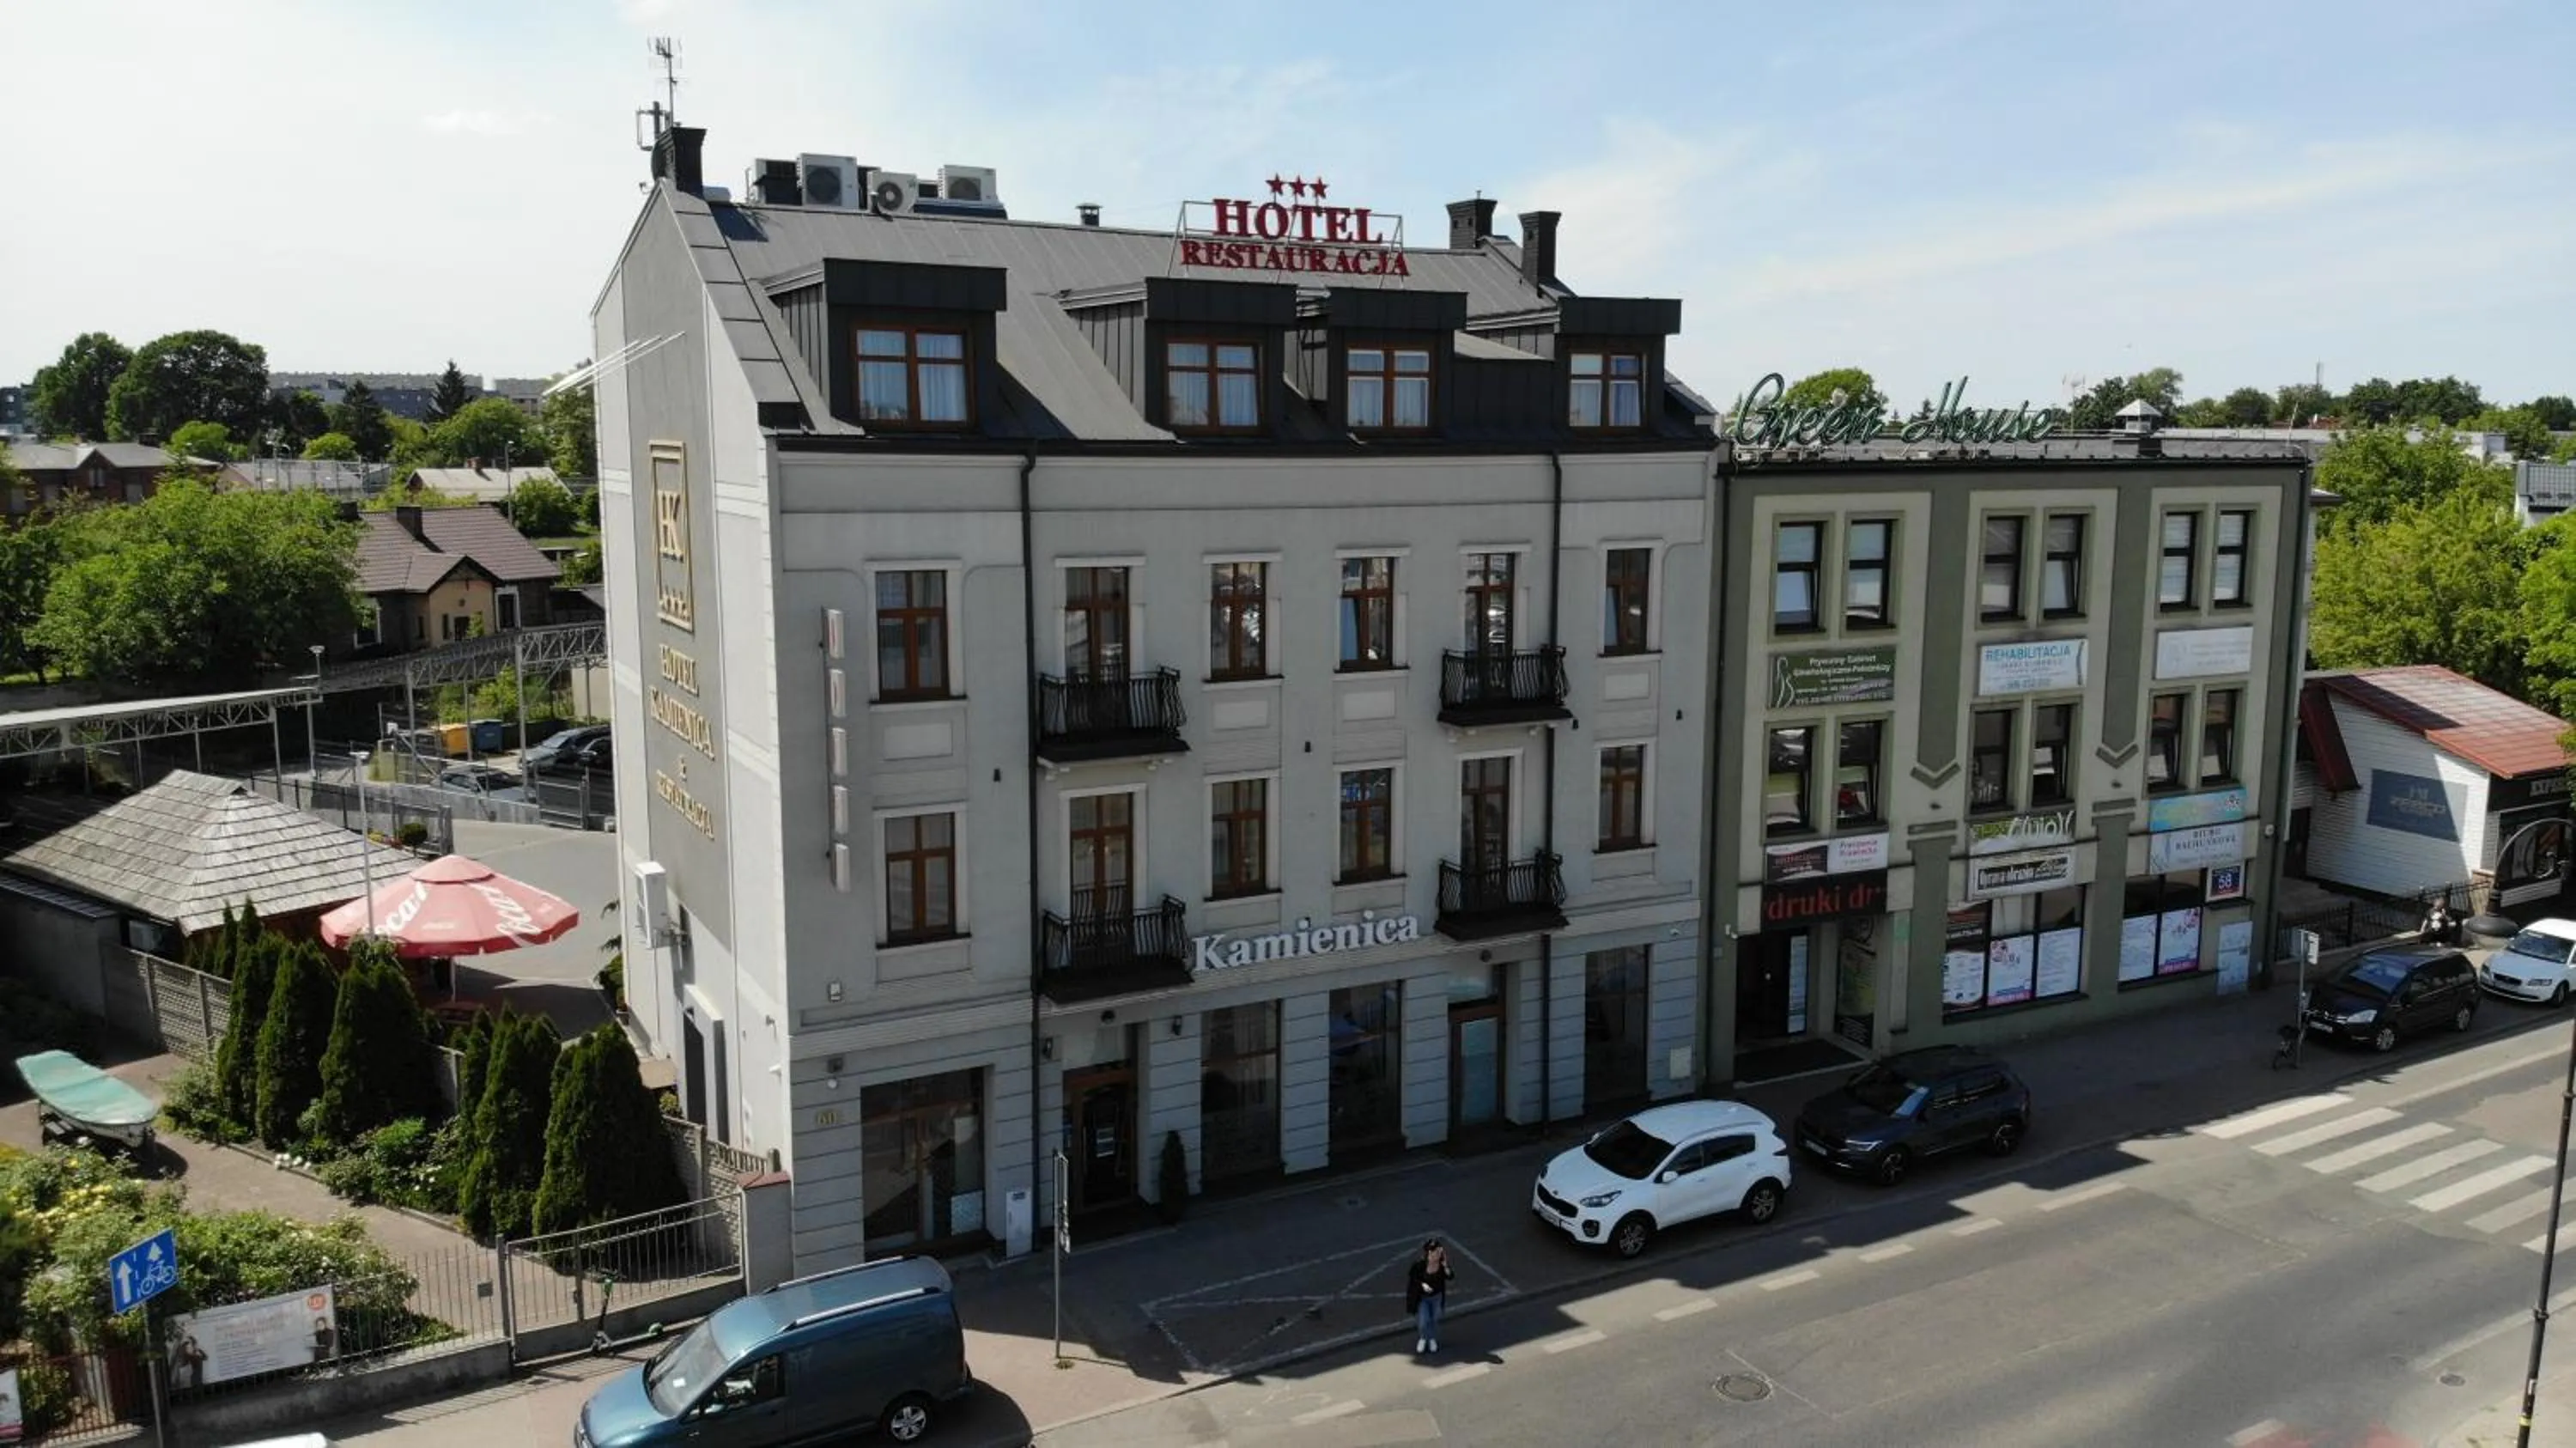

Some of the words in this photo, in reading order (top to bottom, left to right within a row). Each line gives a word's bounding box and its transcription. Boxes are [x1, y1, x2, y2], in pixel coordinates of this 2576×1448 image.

[1212, 198, 1382, 242] HOTEL
[1181, 240, 1410, 277] RESTAURACJA
[1727, 372, 1884, 446] Green
[1900, 375, 2055, 444] House
[659, 643, 699, 697] HOTEL
[1985, 644, 2071, 662] REHABILITACJA
[1768, 885, 1841, 920] druki
[1192, 910, 1419, 971] Kamienica
